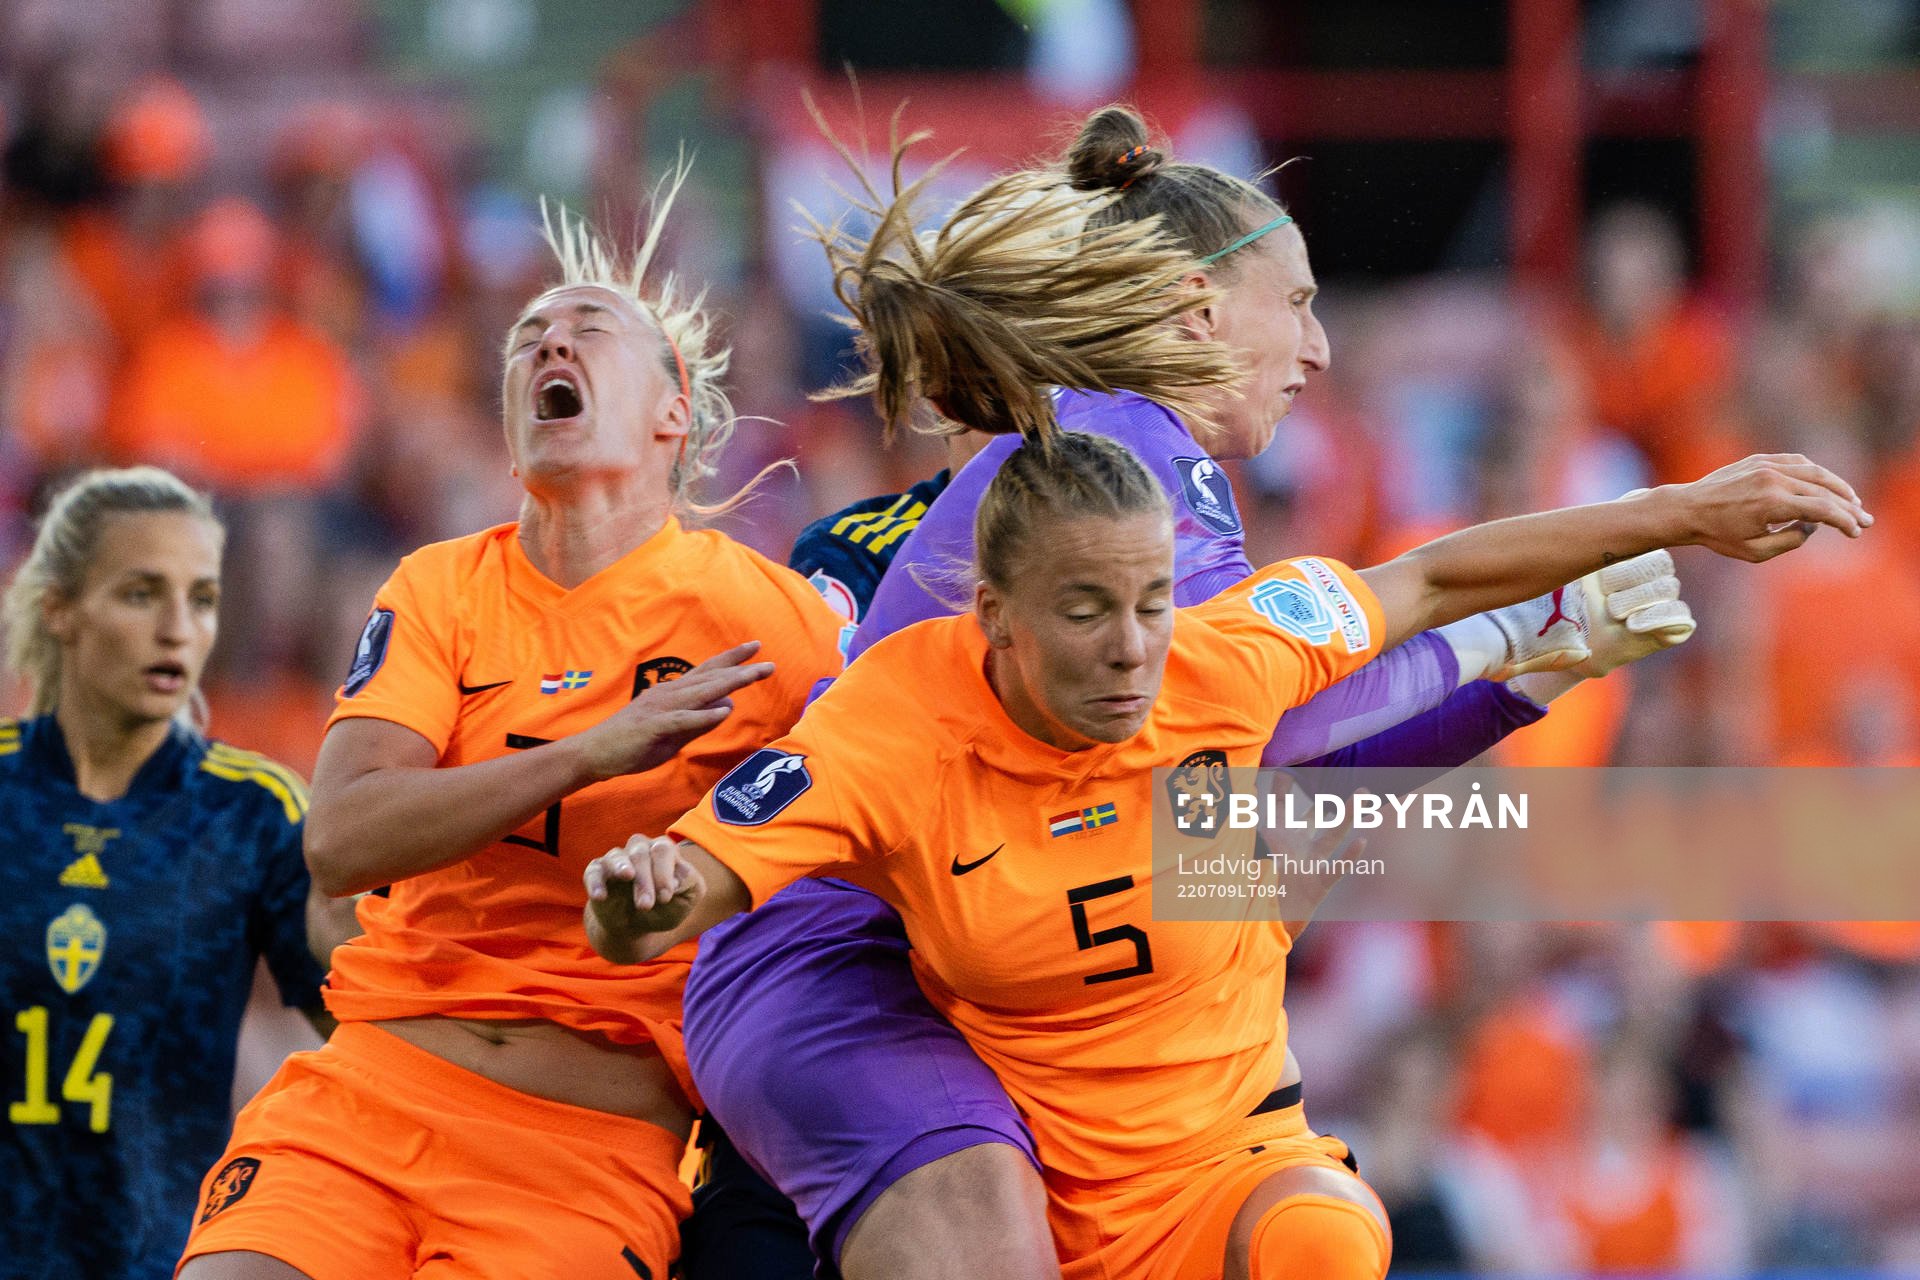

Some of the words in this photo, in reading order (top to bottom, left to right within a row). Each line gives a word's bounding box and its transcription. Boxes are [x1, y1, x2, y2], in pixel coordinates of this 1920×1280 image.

[1303, 560, 1364, 648] FOUNDATION
[718, 790, 756, 819] CHAMPIONS
[726, 785, 761, 812] EUROPEAN
[1067, 875, 1154, 986] 5
[9, 1006, 114, 1133] 14
